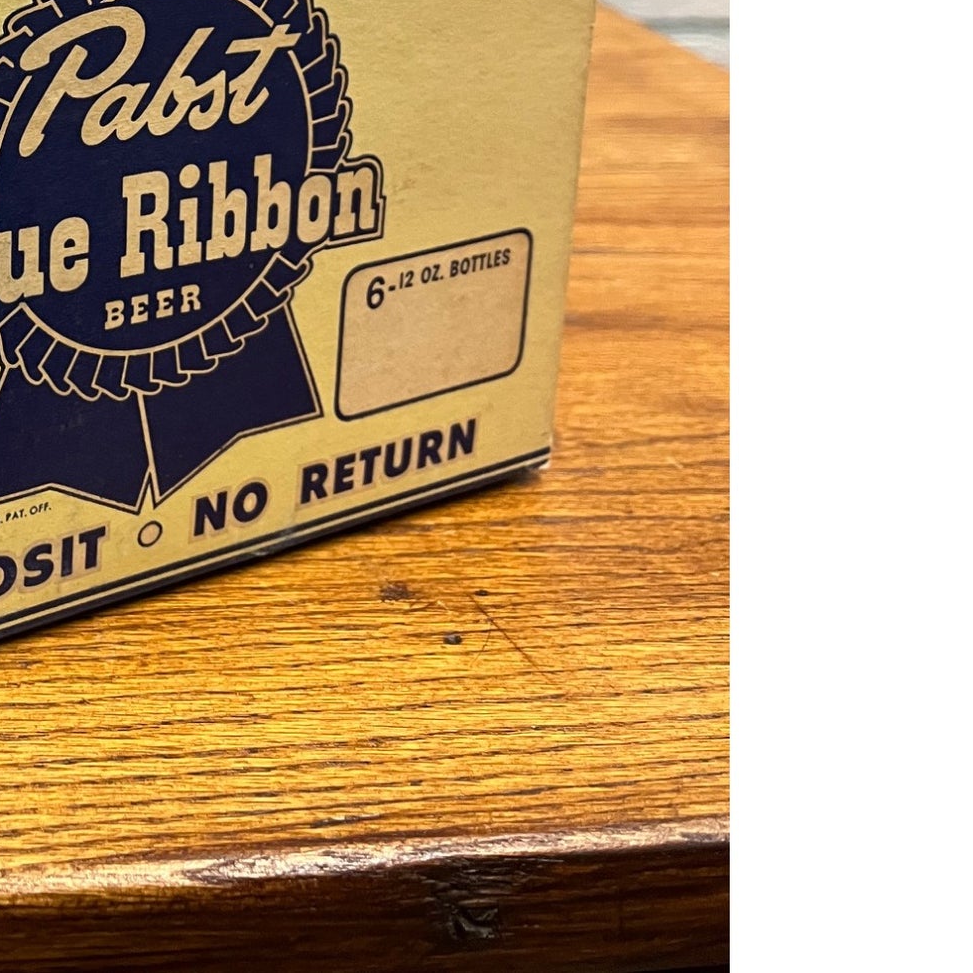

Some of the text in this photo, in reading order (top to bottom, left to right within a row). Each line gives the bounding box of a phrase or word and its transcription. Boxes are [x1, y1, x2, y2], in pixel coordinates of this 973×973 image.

[19, 5, 302, 158] Pabst
[120, 153, 379, 279] Ribbon
[104, 284, 201, 331] BEER
[420, 263, 445, 285] OZ.
[449, 248, 512, 278] BOTTLES
[5, 508, 27, 523] PAT.
[29, 501, 52, 516] OFF.
[193, 481, 268, 537] NO
[299, 418, 476, 505] RETURN
